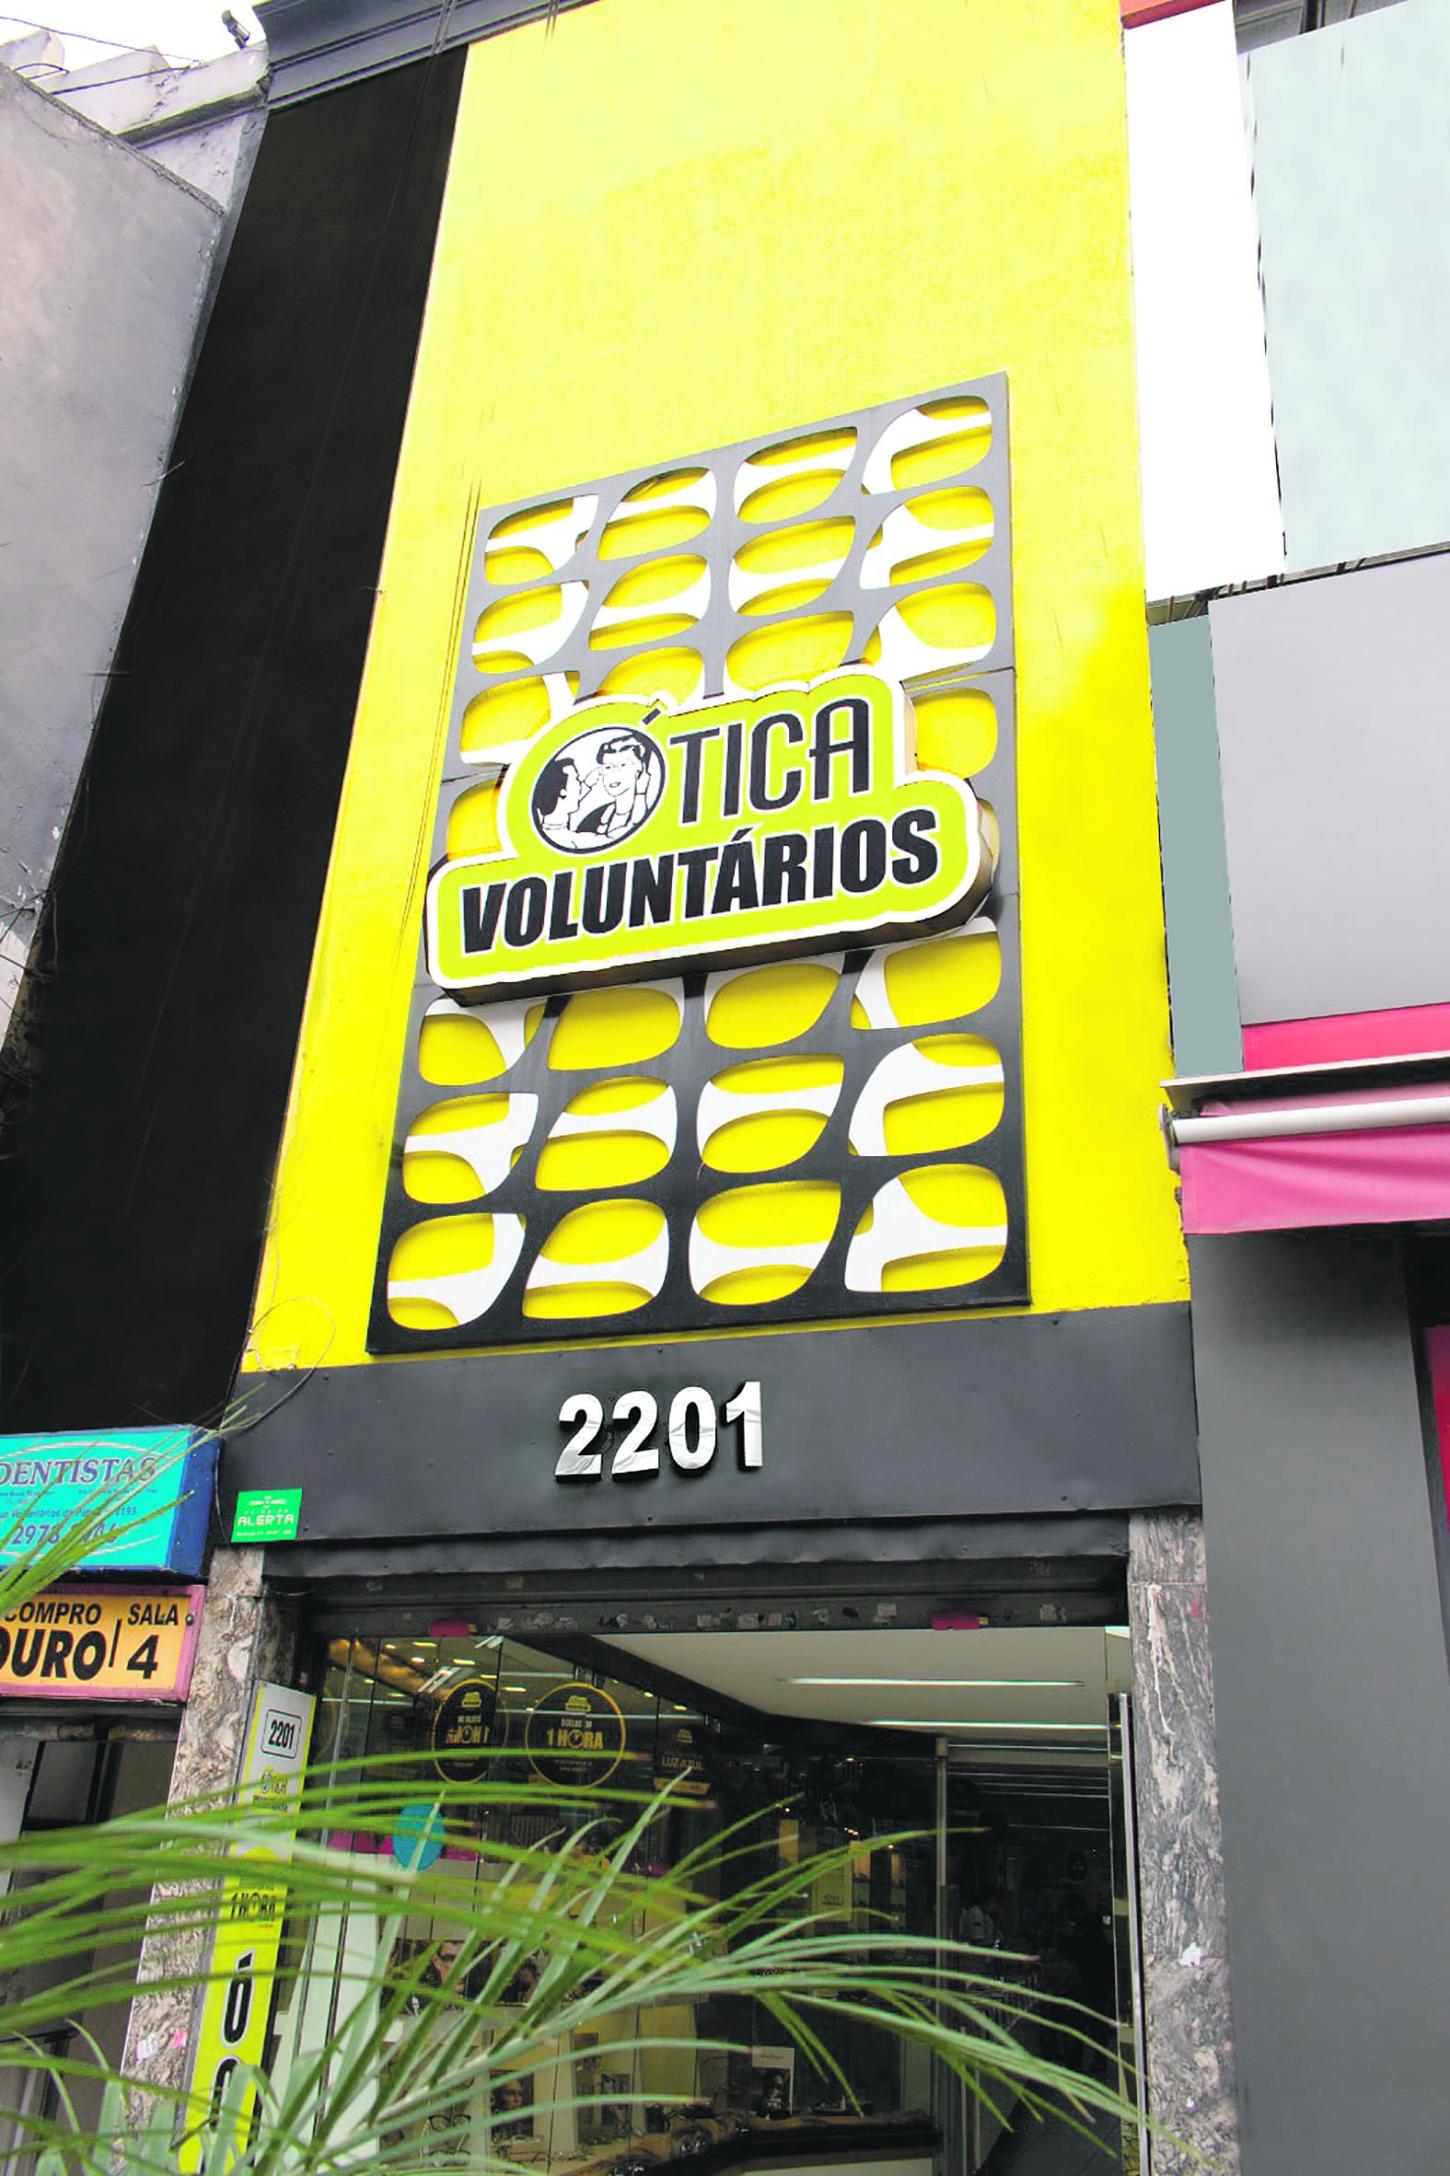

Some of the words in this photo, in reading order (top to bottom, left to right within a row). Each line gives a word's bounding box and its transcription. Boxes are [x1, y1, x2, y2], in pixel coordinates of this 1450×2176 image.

[531, 697, 870, 855] ÓTICA
[461, 808, 938, 953] VOLUNTÁRIOS
[555, 1381, 763, 1480] 2201
[237, 1513, 295, 1527] ALERTA
[127, 1603, 179, 1626] SALA
[126, 1634, 160, 1680] 4
[268, 1719, 296, 1750] 2201
[557, 1728, 604, 1750] HORA
